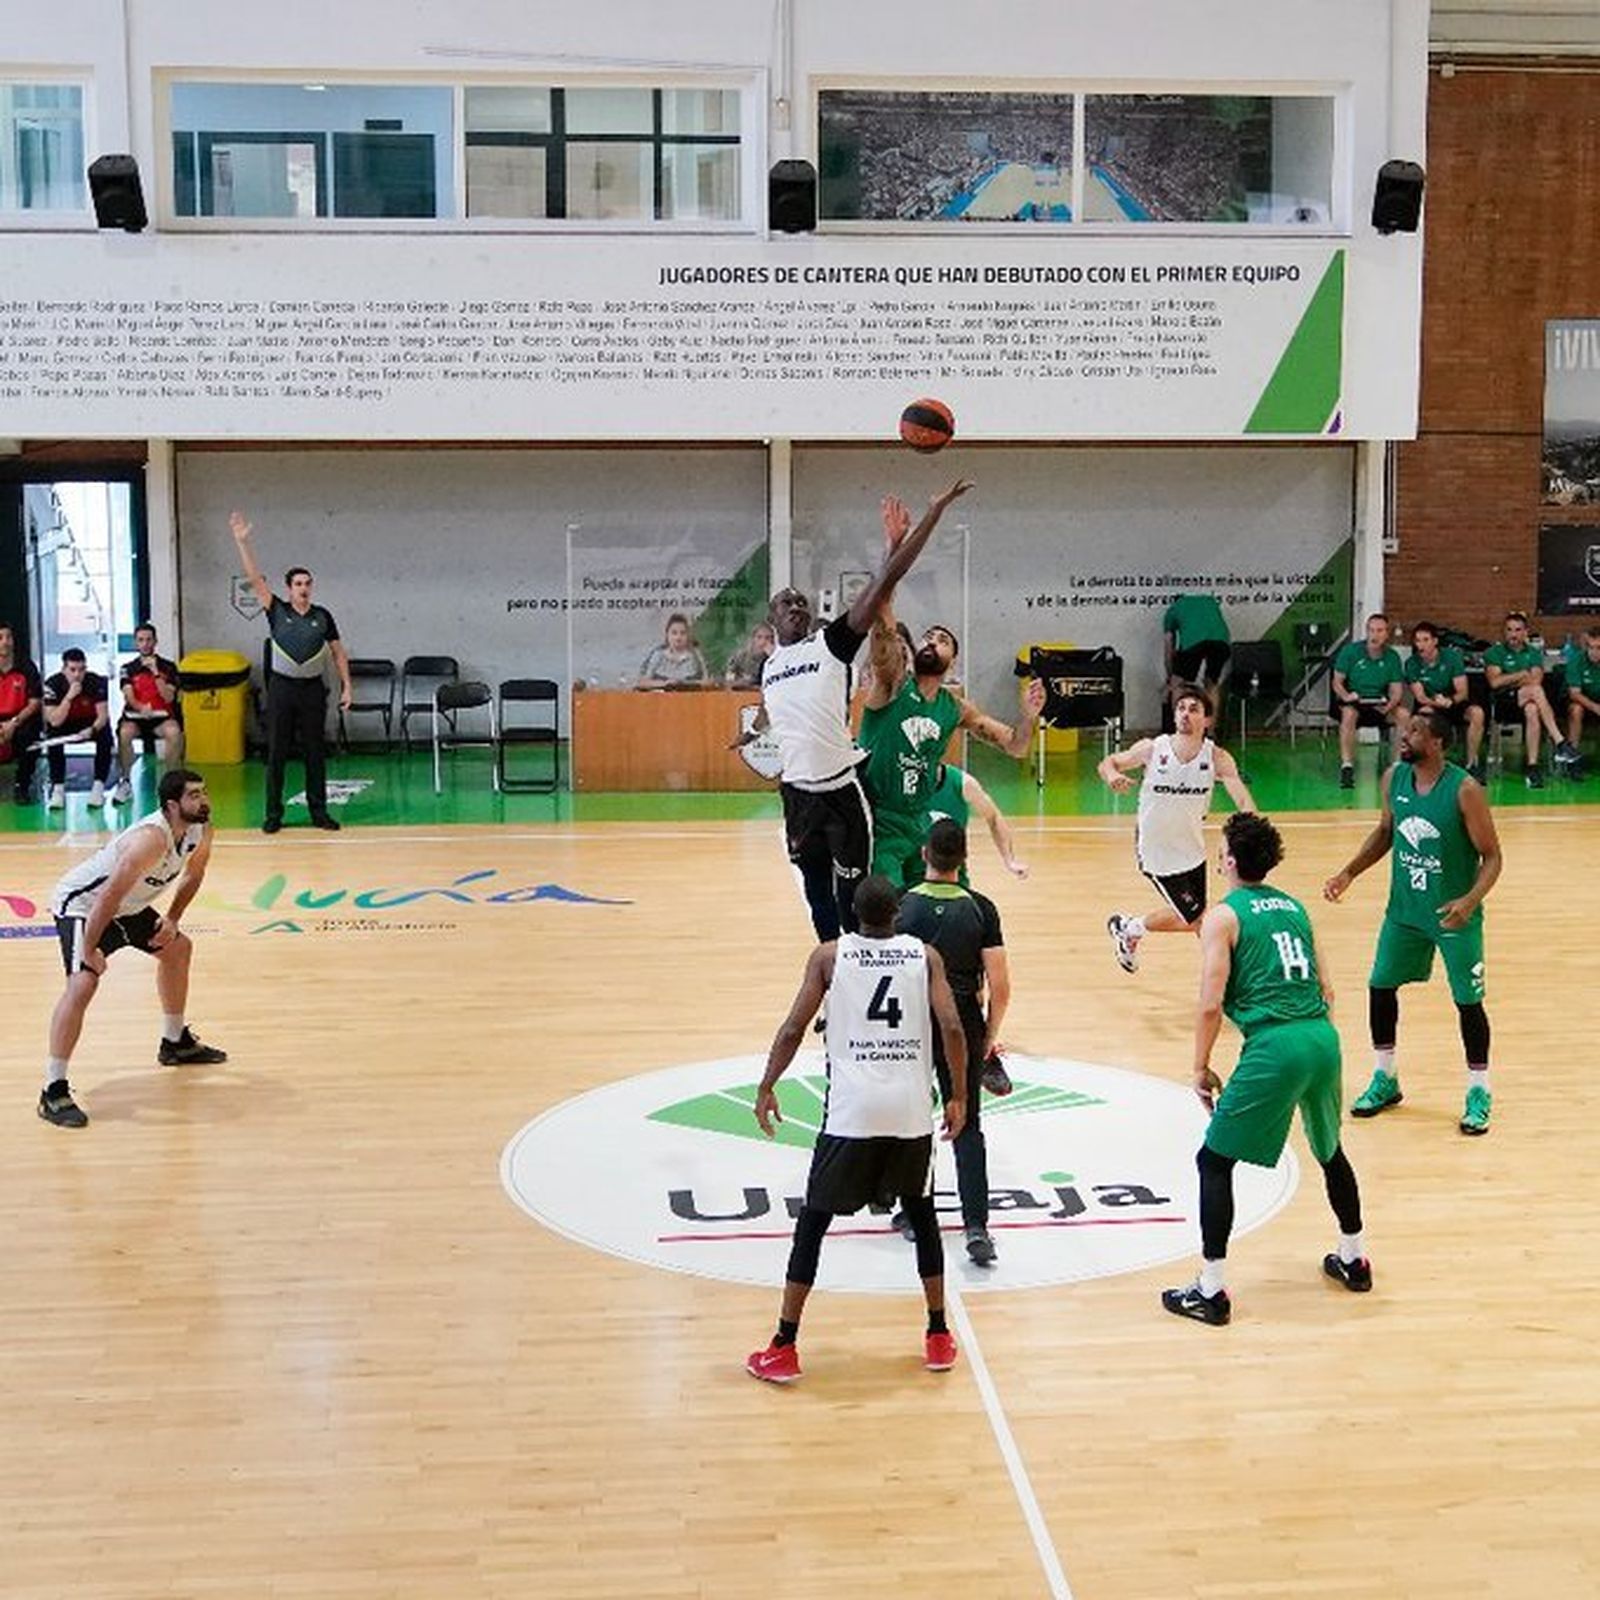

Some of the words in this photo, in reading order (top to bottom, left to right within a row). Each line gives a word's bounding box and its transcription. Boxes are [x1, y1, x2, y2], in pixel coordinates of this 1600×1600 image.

[659, 267, 769, 285] JUGADORES
[775, 267, 799, 284] DE
[803, 267, 890, 284] CANTERA
[895, 267, 933, 286] QUE
[938, 267, 978, 284] HAN
[984, 267, 1083, 284] DEBUTADO
[1087, 267, 1126, 284] CON
[1131, 267, 1152, 283] EL
[1156, 266, 1228, 283] PRIMER
[1232, 265, 1301, 285] EQUIPO
[1271, 930, 1309, 981] 14
[866, 975, 903, 1029] 4
